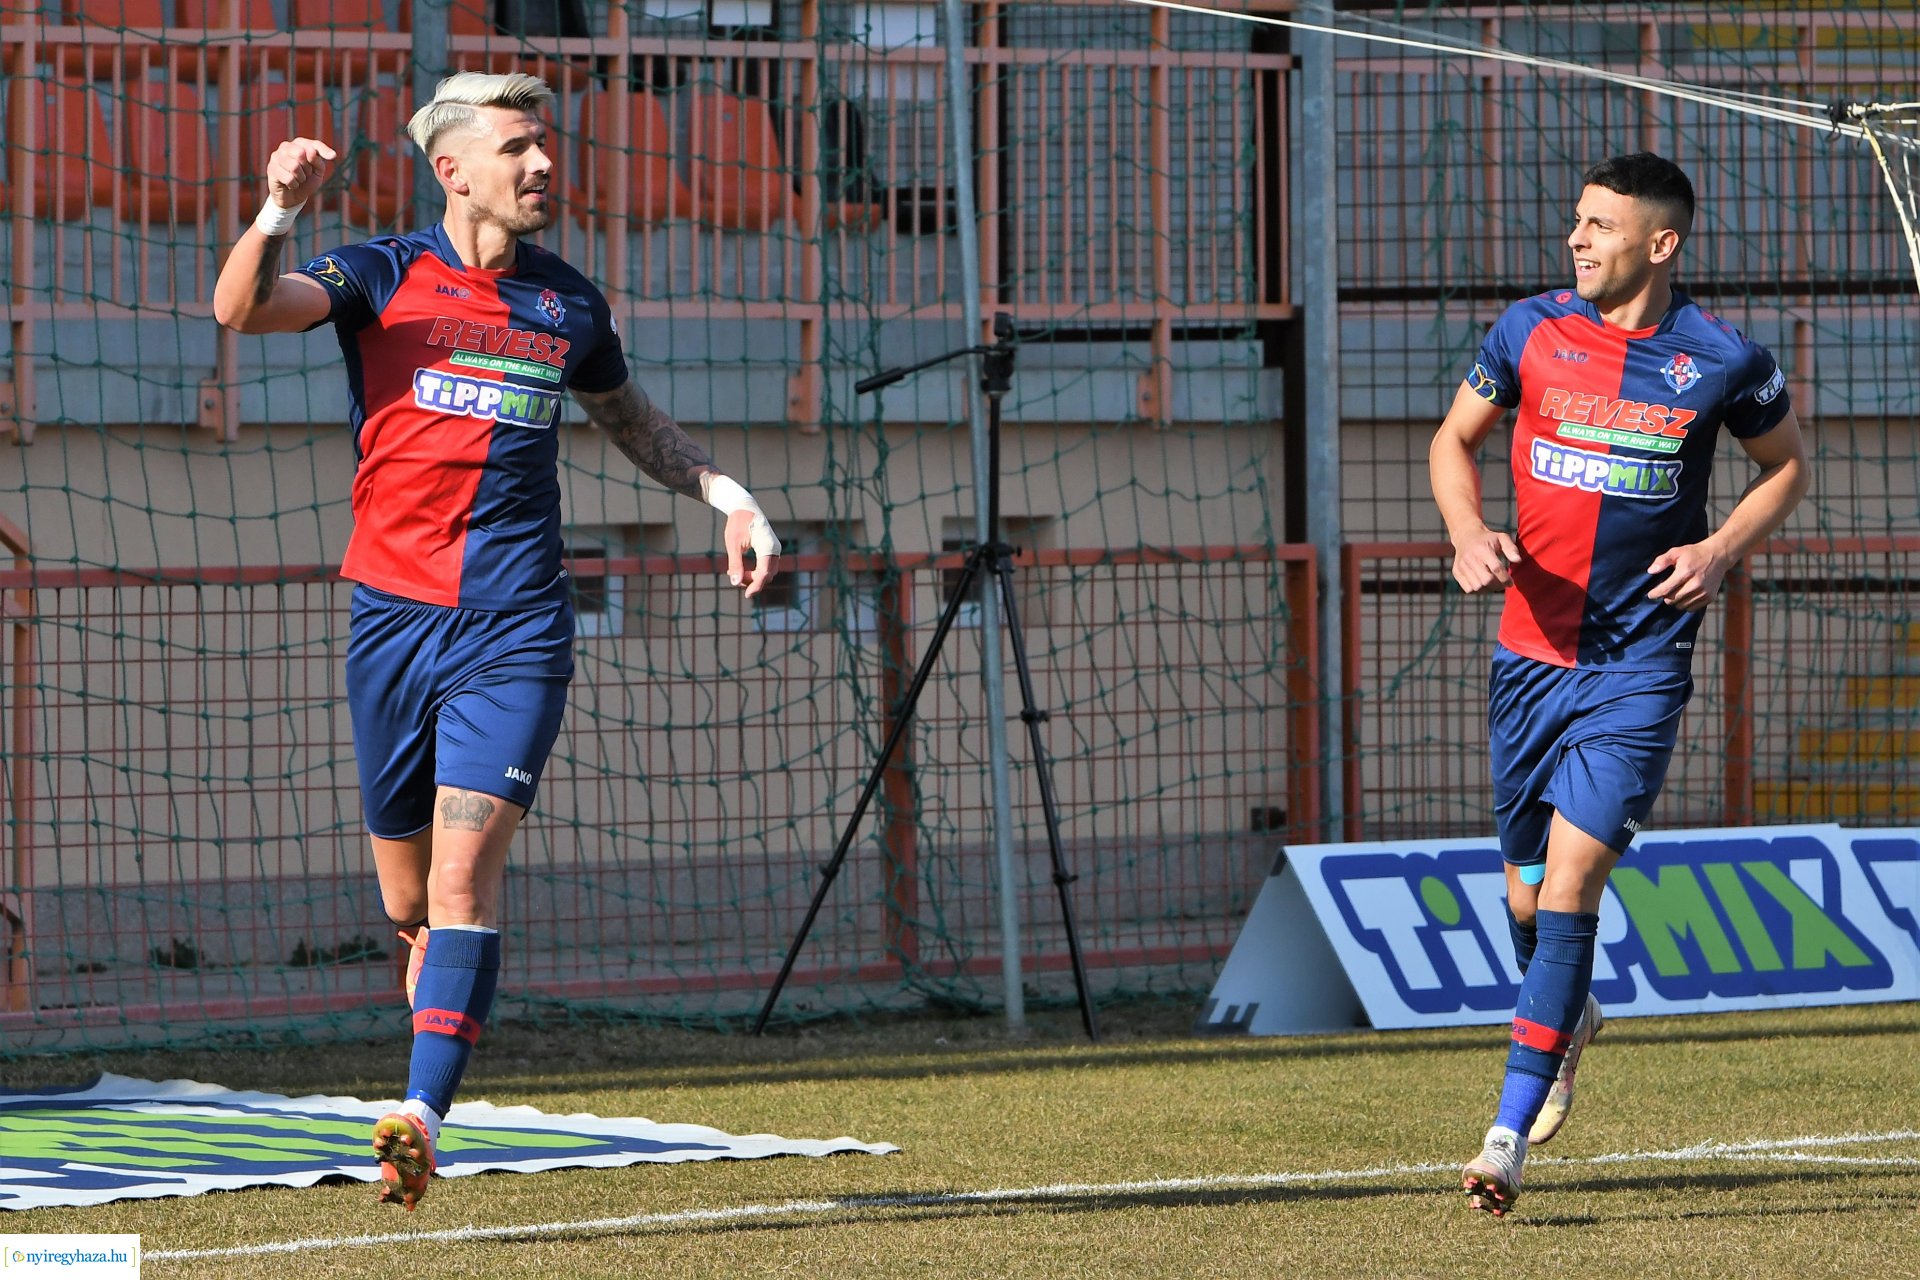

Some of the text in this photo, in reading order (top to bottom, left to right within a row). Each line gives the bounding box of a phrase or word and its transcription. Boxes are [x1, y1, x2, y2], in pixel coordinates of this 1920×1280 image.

[435, 284, 470, 299] JAKO
[427, 316, 570, 368] REVESZ
[1552, 348, 1589, 363] JAKO
[454, 354, 488, 365] ALWAYS
[505, 362, 520, 370] THE
[522, 364, 545, 374] RIGHT
[546, 369, 559, 379] WAY
[1539, 387, 1697, 438] REVESZ
[1561, 426, 1678, 450] ALWAYS ON THE RIGHT WAY
[504, 765, 533, 786] JAKO
[1623, 817, 1641, 834] JAK
[424, 1013, 472, 1033] JAKO
